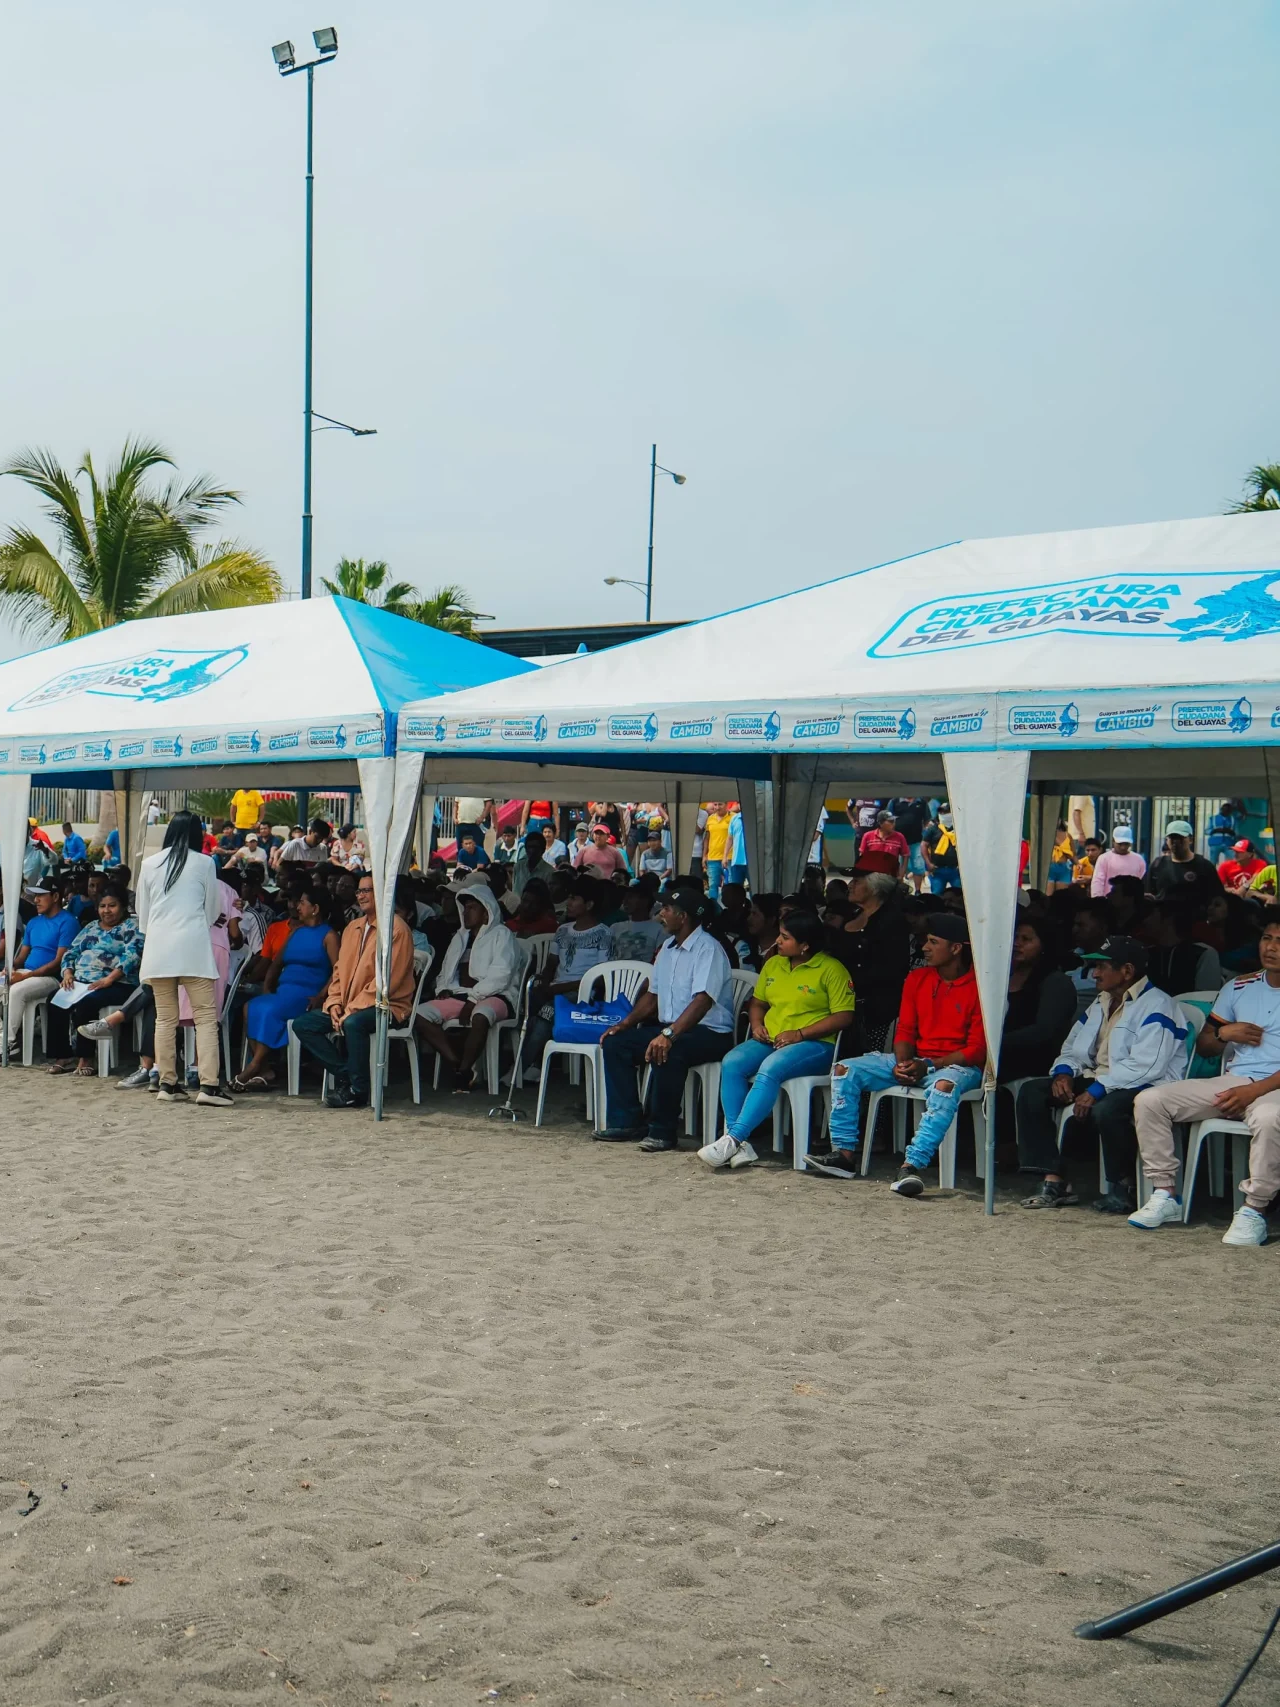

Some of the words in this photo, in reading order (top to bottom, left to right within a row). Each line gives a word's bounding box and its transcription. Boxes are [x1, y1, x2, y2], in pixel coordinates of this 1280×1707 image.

[927, 584, 1181, 620] PREFECTURA
[915, 596, 1170, 633] CIUDADANA
[898, 629, 975, 648] DEL
[988, 609, 1164, 634] GUAYAS
[932, 719, 980, 734] CAMBIO
[1098, 715, 1152, 730] CAMBIO
[560, 726, 595, 737] CAMBIO
[672, 724, 711, 737] CAMBIO
[795, 723, 838, 737] CAMBIO
[192, 741, 216, 753] CAMBIO
[270, 737, 297, 749] CAMBIO
